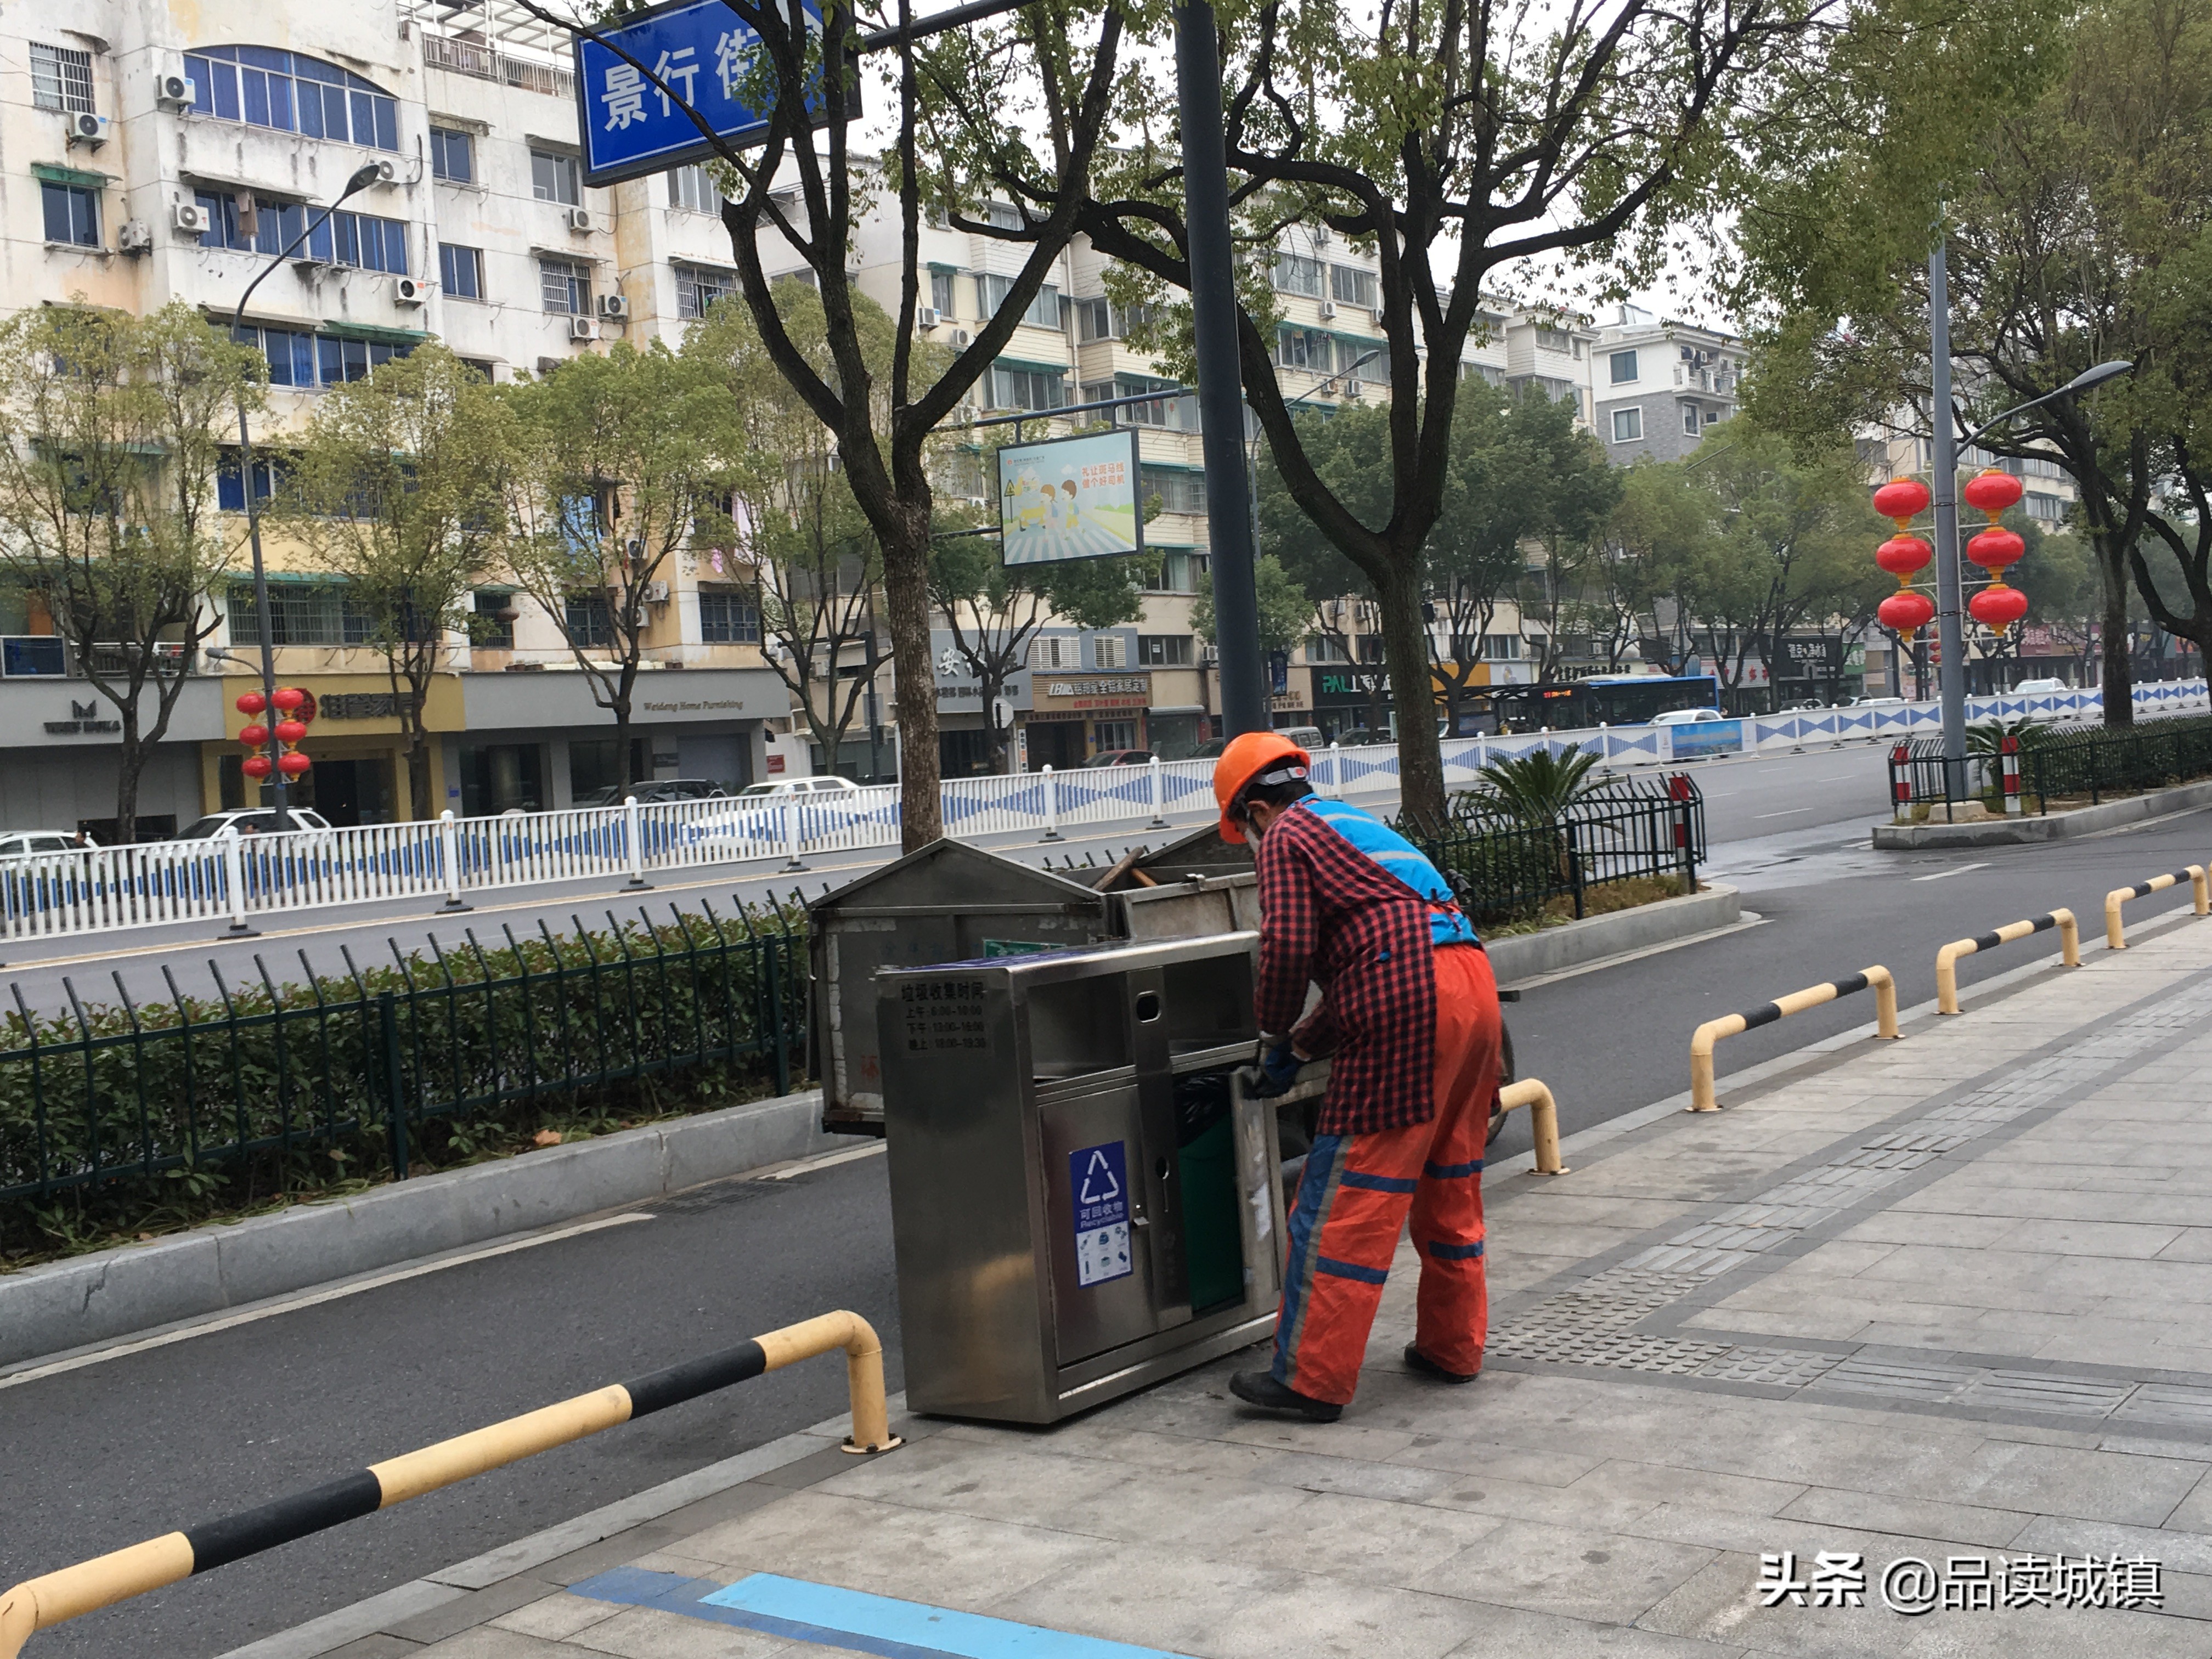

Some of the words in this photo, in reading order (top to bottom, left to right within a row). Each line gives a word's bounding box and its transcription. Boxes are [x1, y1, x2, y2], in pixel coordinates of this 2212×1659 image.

[1082, 461, 1125, 477] 礼让斑马线
[1082, 475, 1125, 489] 做个好司机
[901, 981, 984, 1002] 垃圾收集时间
[1079, 1201, 1123, 1220] 可回收物
